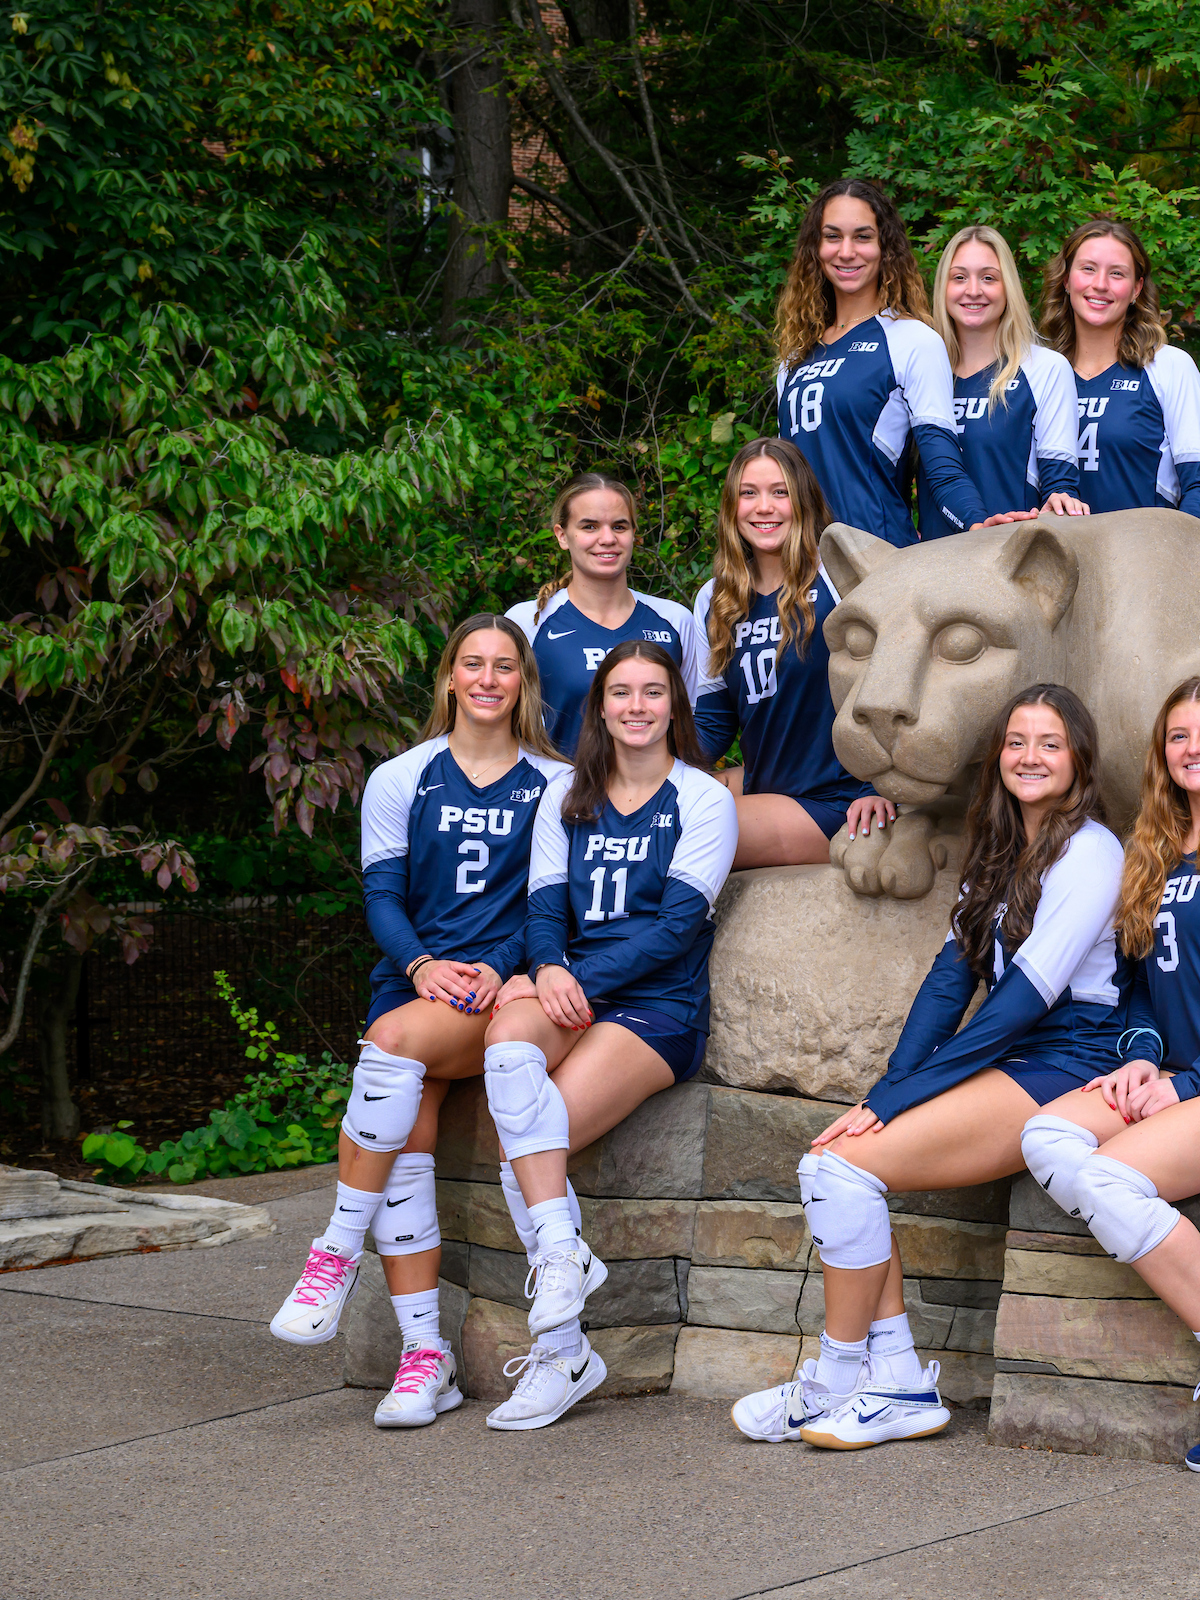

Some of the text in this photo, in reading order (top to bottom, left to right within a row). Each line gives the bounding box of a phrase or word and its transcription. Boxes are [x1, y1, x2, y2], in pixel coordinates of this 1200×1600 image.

[788, 357, 846, 386] PSU
[787, 382, 825, 437] 18
[953, 397, 989, 419] SU
[1077, 397, 1110, 418] SU
[740, 648, 778, 704] 10
[438, 805, 514, 836] PSU
[455, 839, 490, 894] 2
[583, 833, 651, 862] PSU
[583, 866, 631, 922] 11
[1153, 911, 1180, 973] 3
